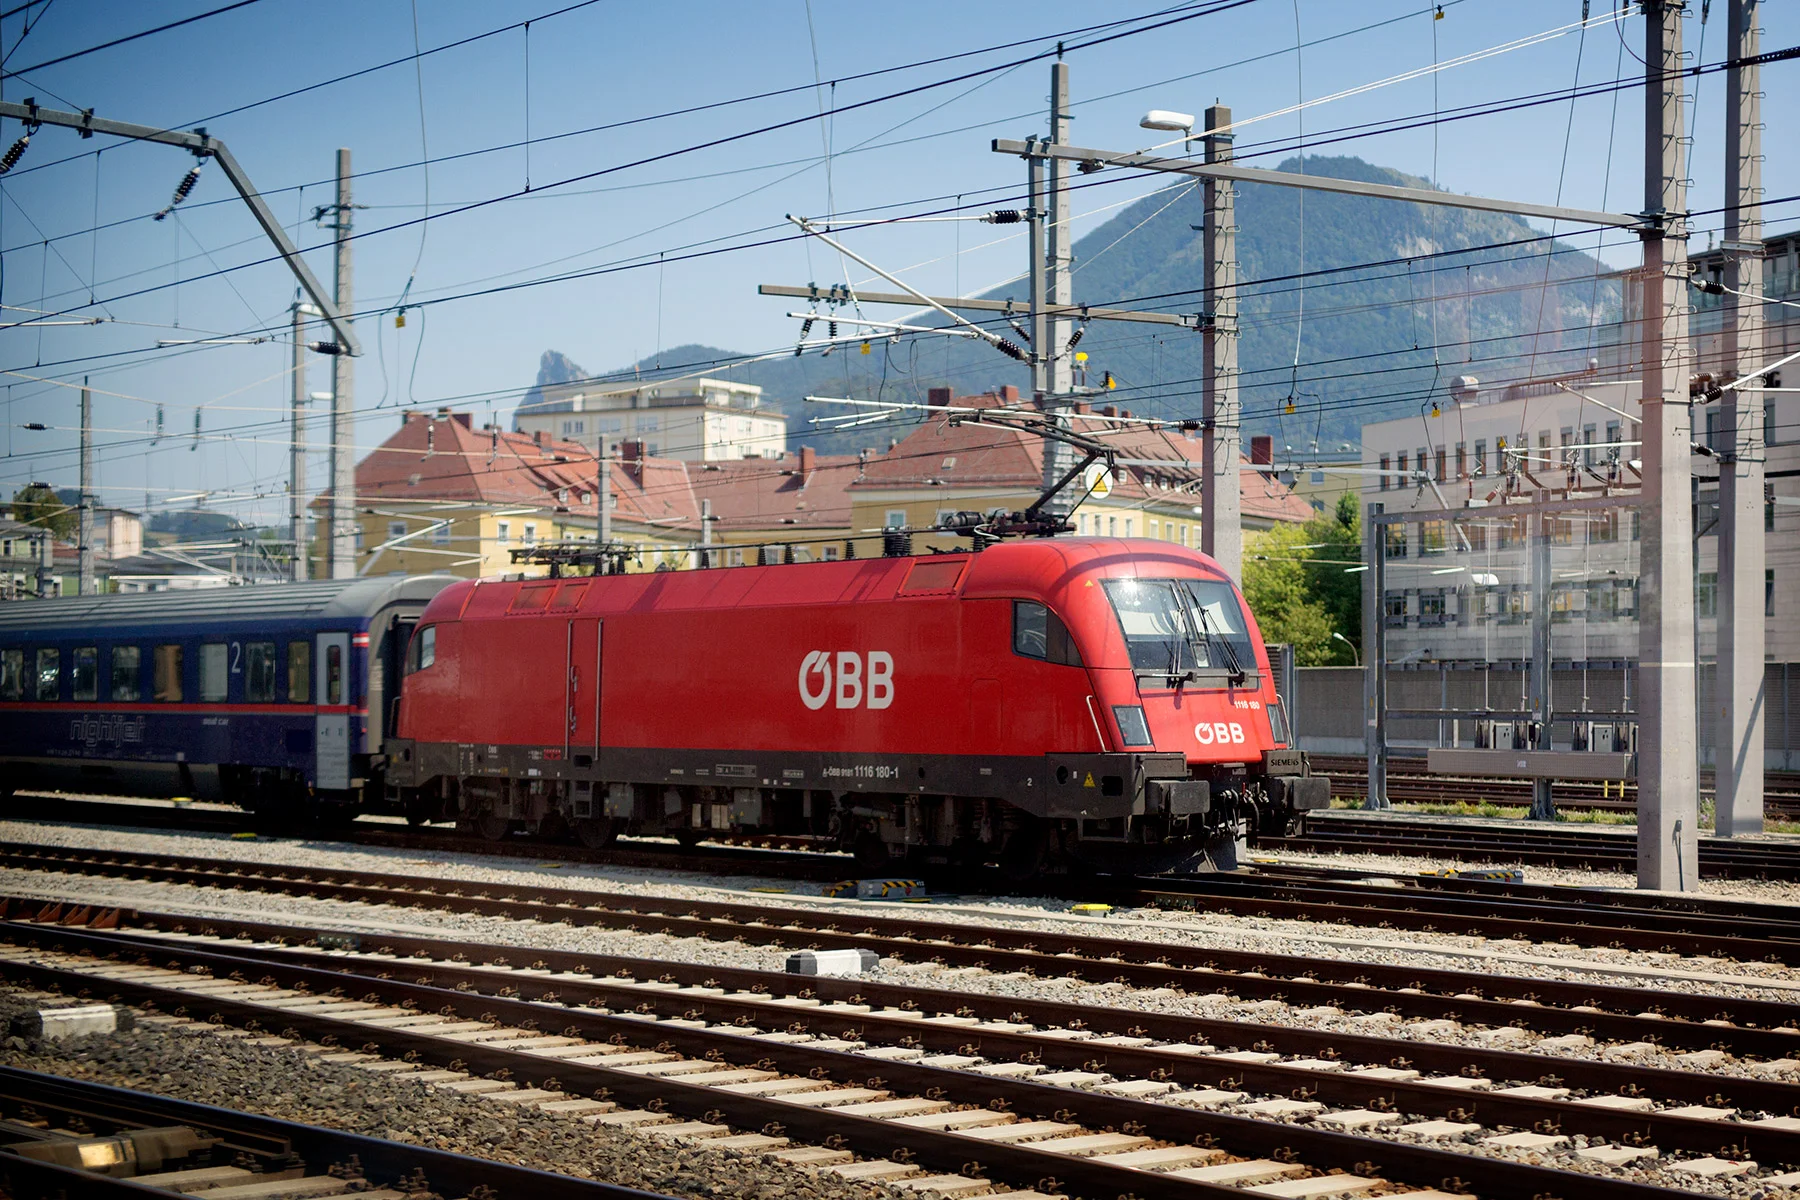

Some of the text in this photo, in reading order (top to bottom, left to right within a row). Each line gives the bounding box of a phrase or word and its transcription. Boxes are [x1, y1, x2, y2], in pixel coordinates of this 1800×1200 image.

[231, 641, 241, 673] 2
[798, 650, 895, 710] ÖBB
[70, 714, 145, 748] nightjet
[1194, 722, 1245, 745] ÖBB
[854, 765, 873, 778] 1116
[875, 766, 898, 779] 180-1
[1270, 758, 1299, 766] SIEMENS
[1026, 777, 1033, 787] 2
